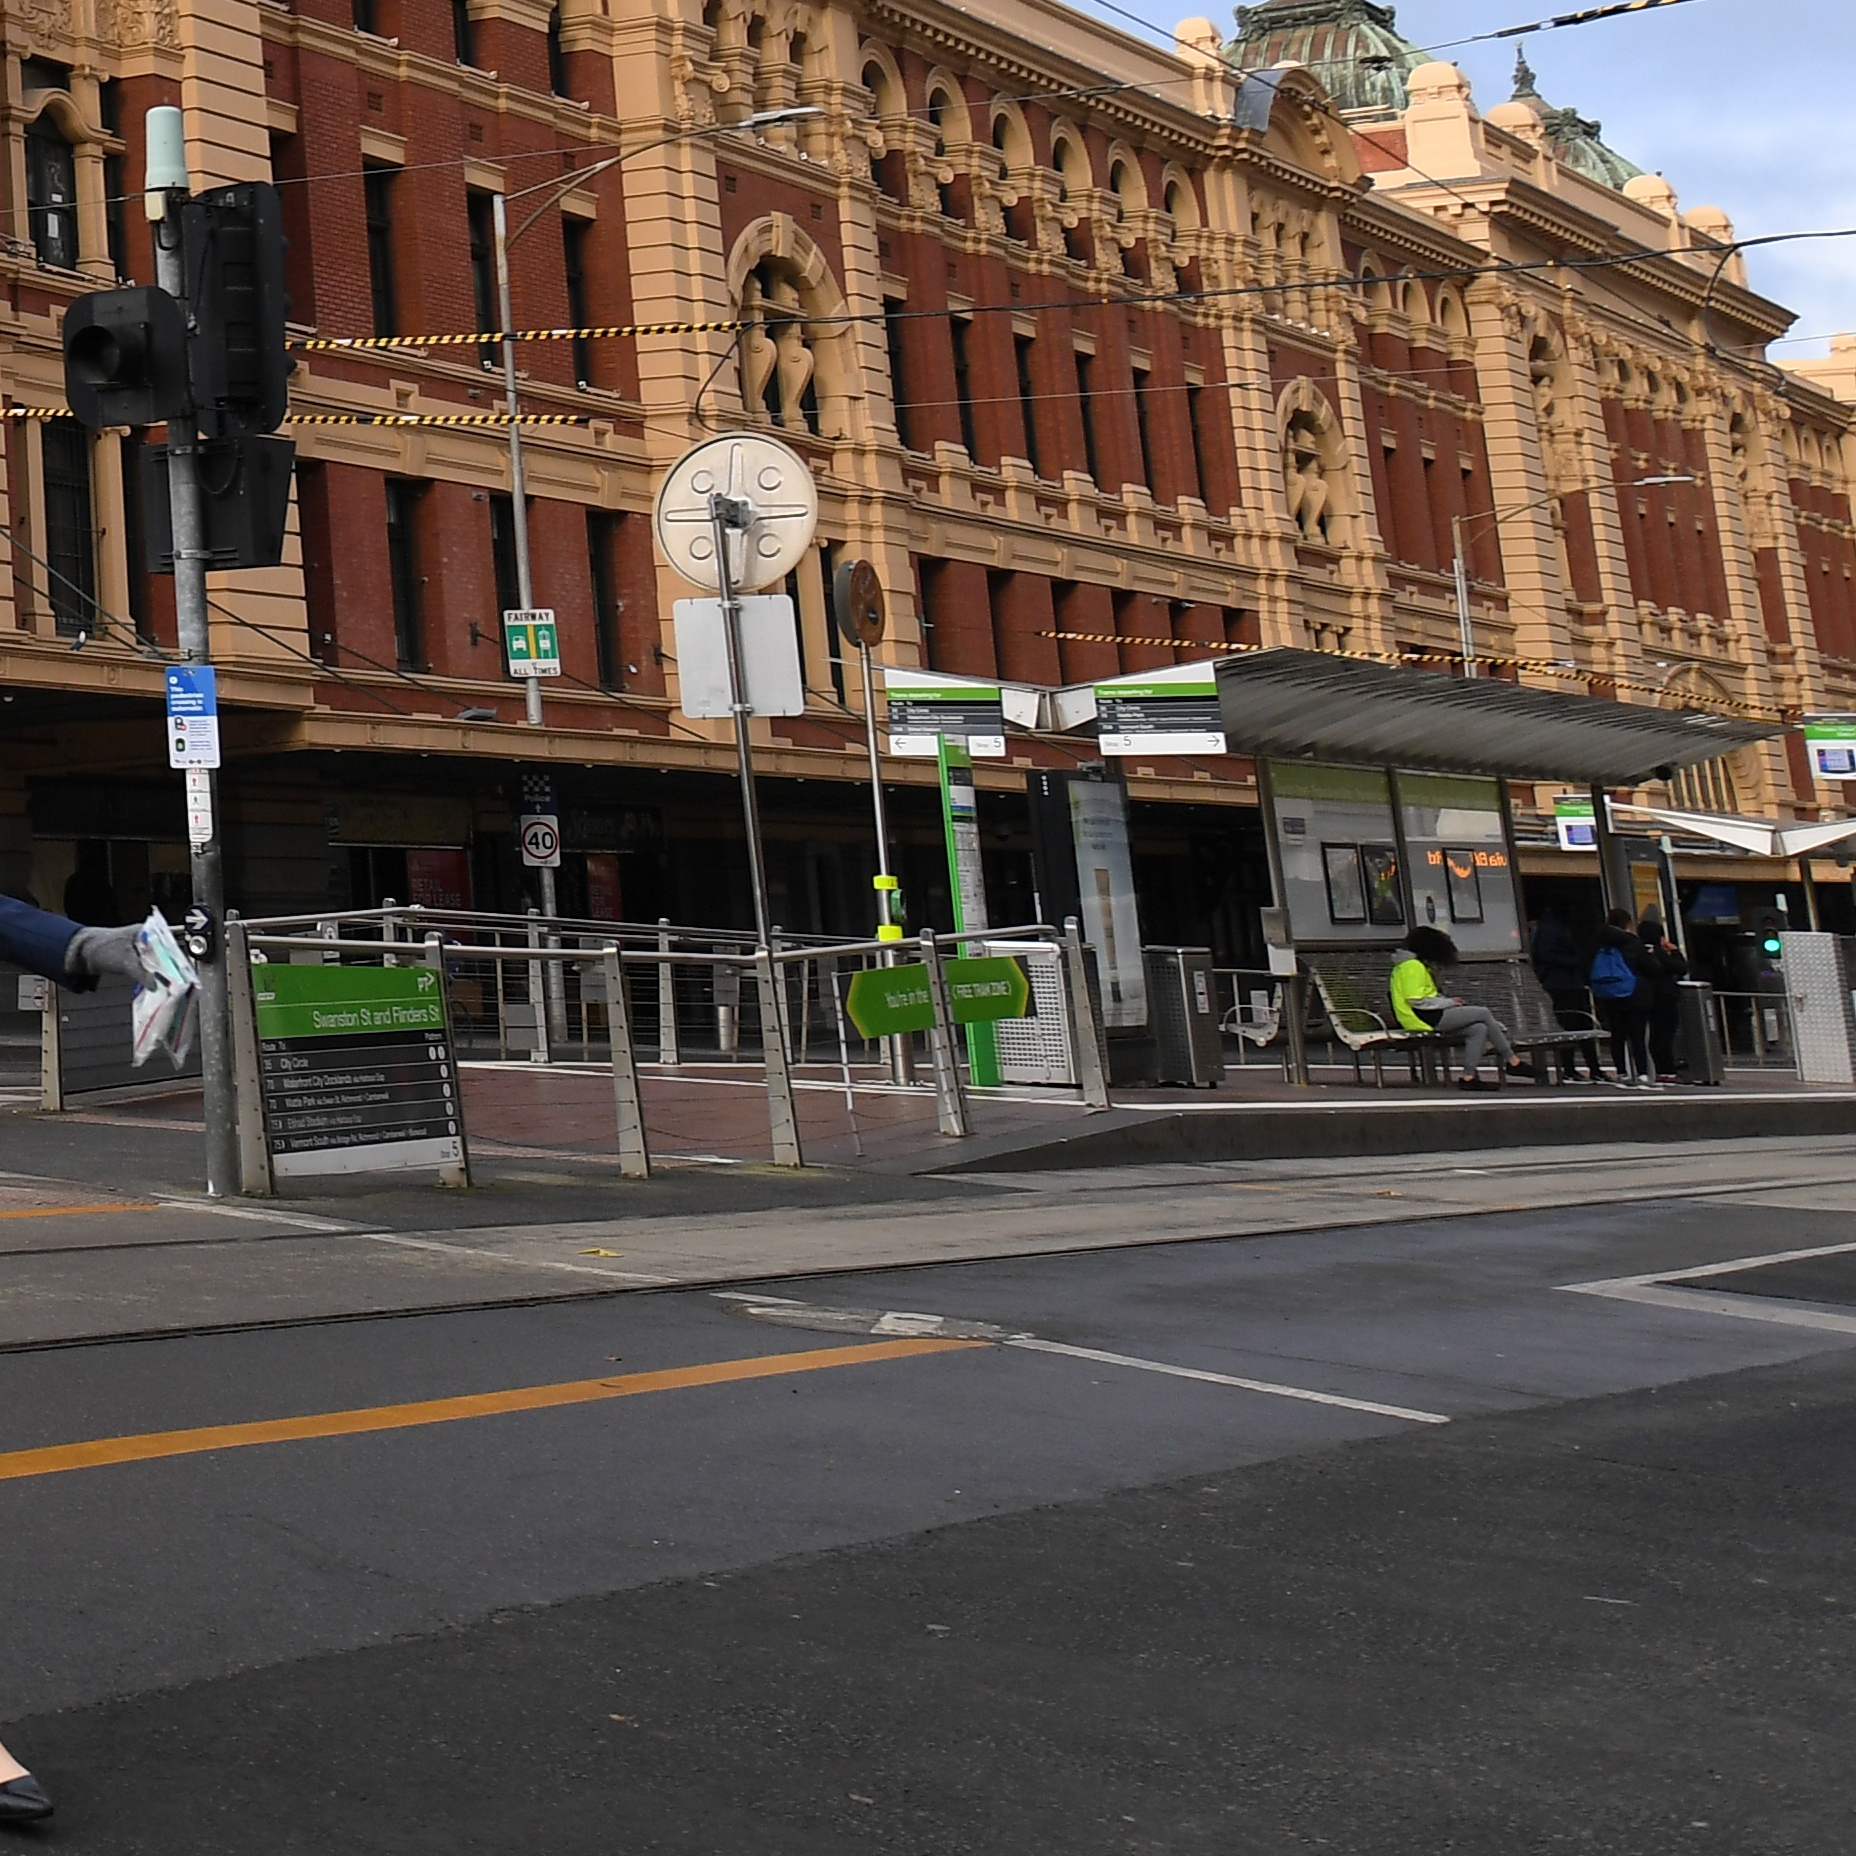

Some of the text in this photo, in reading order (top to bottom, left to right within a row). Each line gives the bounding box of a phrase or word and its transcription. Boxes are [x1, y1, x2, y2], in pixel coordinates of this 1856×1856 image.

[507, 612, 550, 622] FAIRWAY
[533, 667, 558, 675] TIMES
[993, 737, 1002, 748] 5
[1123, 736, 1132, 746] 5
[524, 794, 551, 803] Police
[527, 831, 554, 850] 40
[435, 893, 461, 906] LEASE
[313, 1004, 441, 1028] Swanston St and Flinders St
[280, 1057, 309, 1072] City Circle
[283, 1076, 312, 1089] Waterfront
[312, 1076, 324, 1089] City
[324, 1074, 353, 1085] Docklands
[452, 1140, 460, 1157] 5
